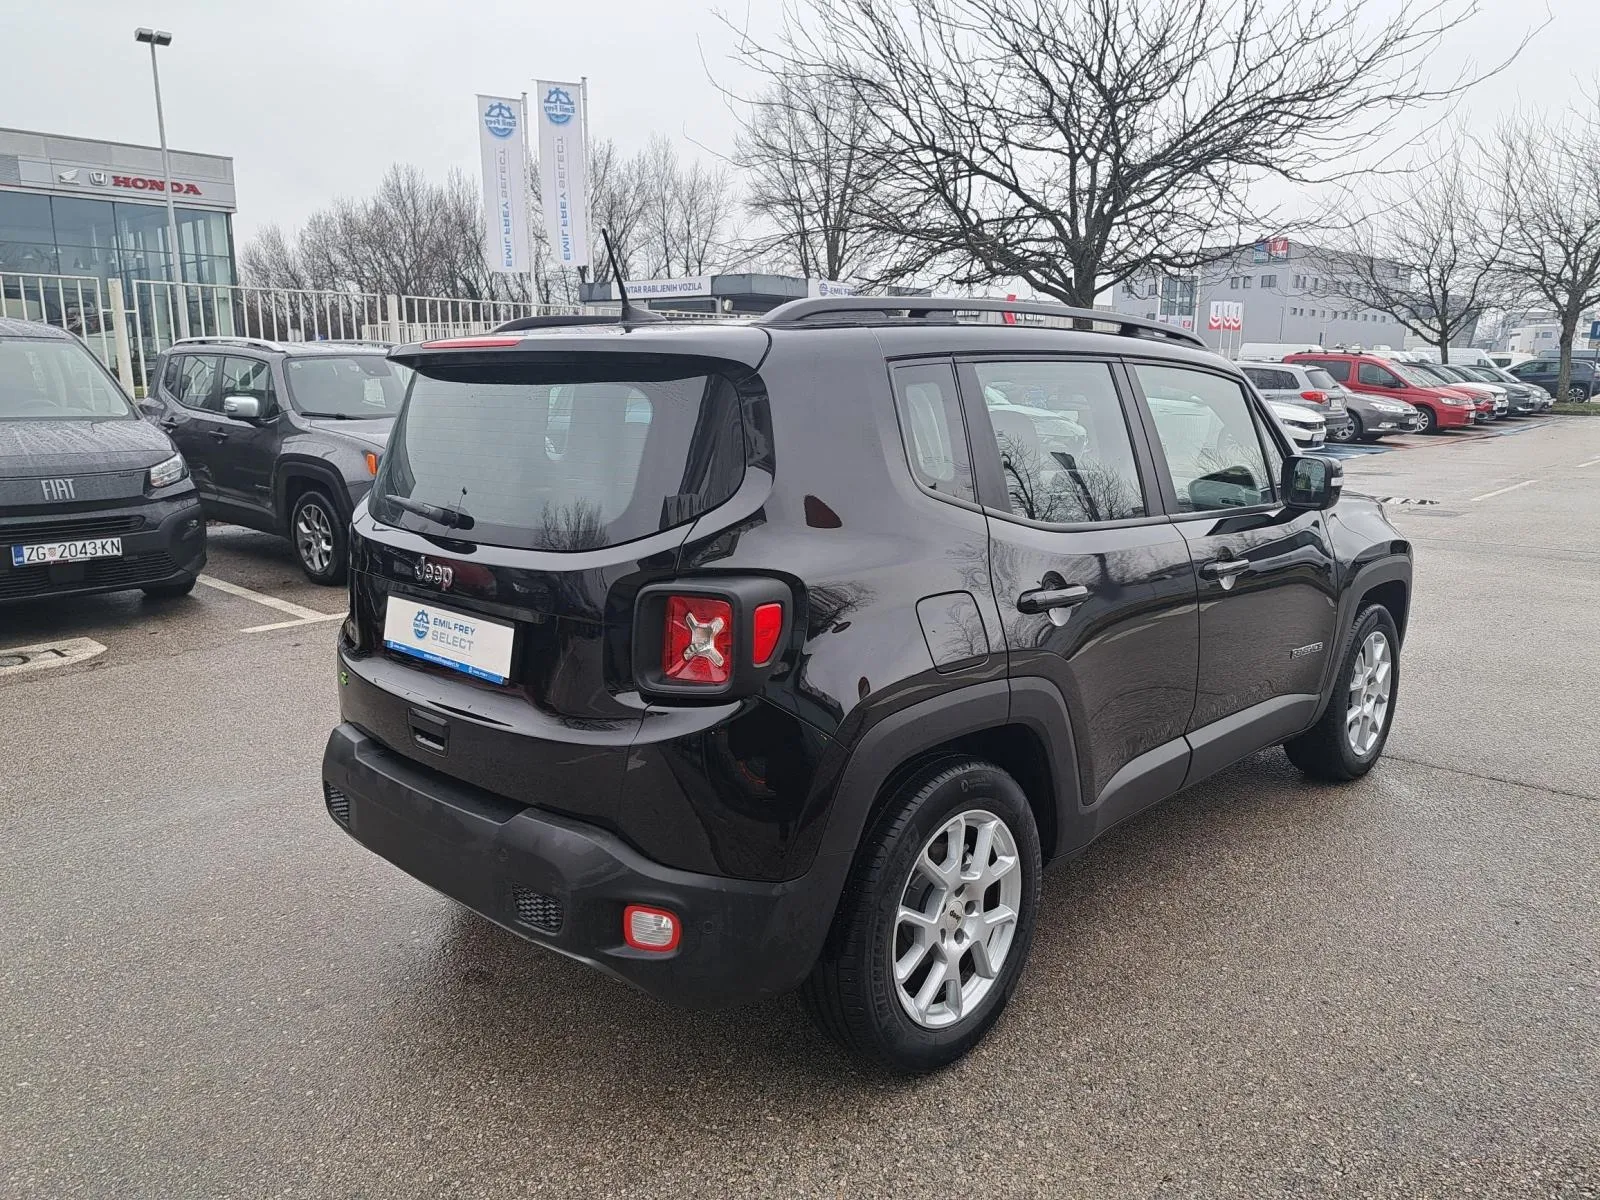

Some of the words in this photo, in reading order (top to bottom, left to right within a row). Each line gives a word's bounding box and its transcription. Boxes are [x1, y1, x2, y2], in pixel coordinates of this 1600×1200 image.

[112, 175, 202, 195] HONDA
[643, 284, 678, 293] RABLJENIH
[679, 282, 702, 291] VOZILA
[41, 479, 75, 500] FIAT
[26, 545, 46, 561] ZG
[414, 556, 453, 591] Jeep
[433, 617, 453, 630] EMIL
[454, 623, 476, 635] FREY
[432, 630, 474, 651] SELECT
